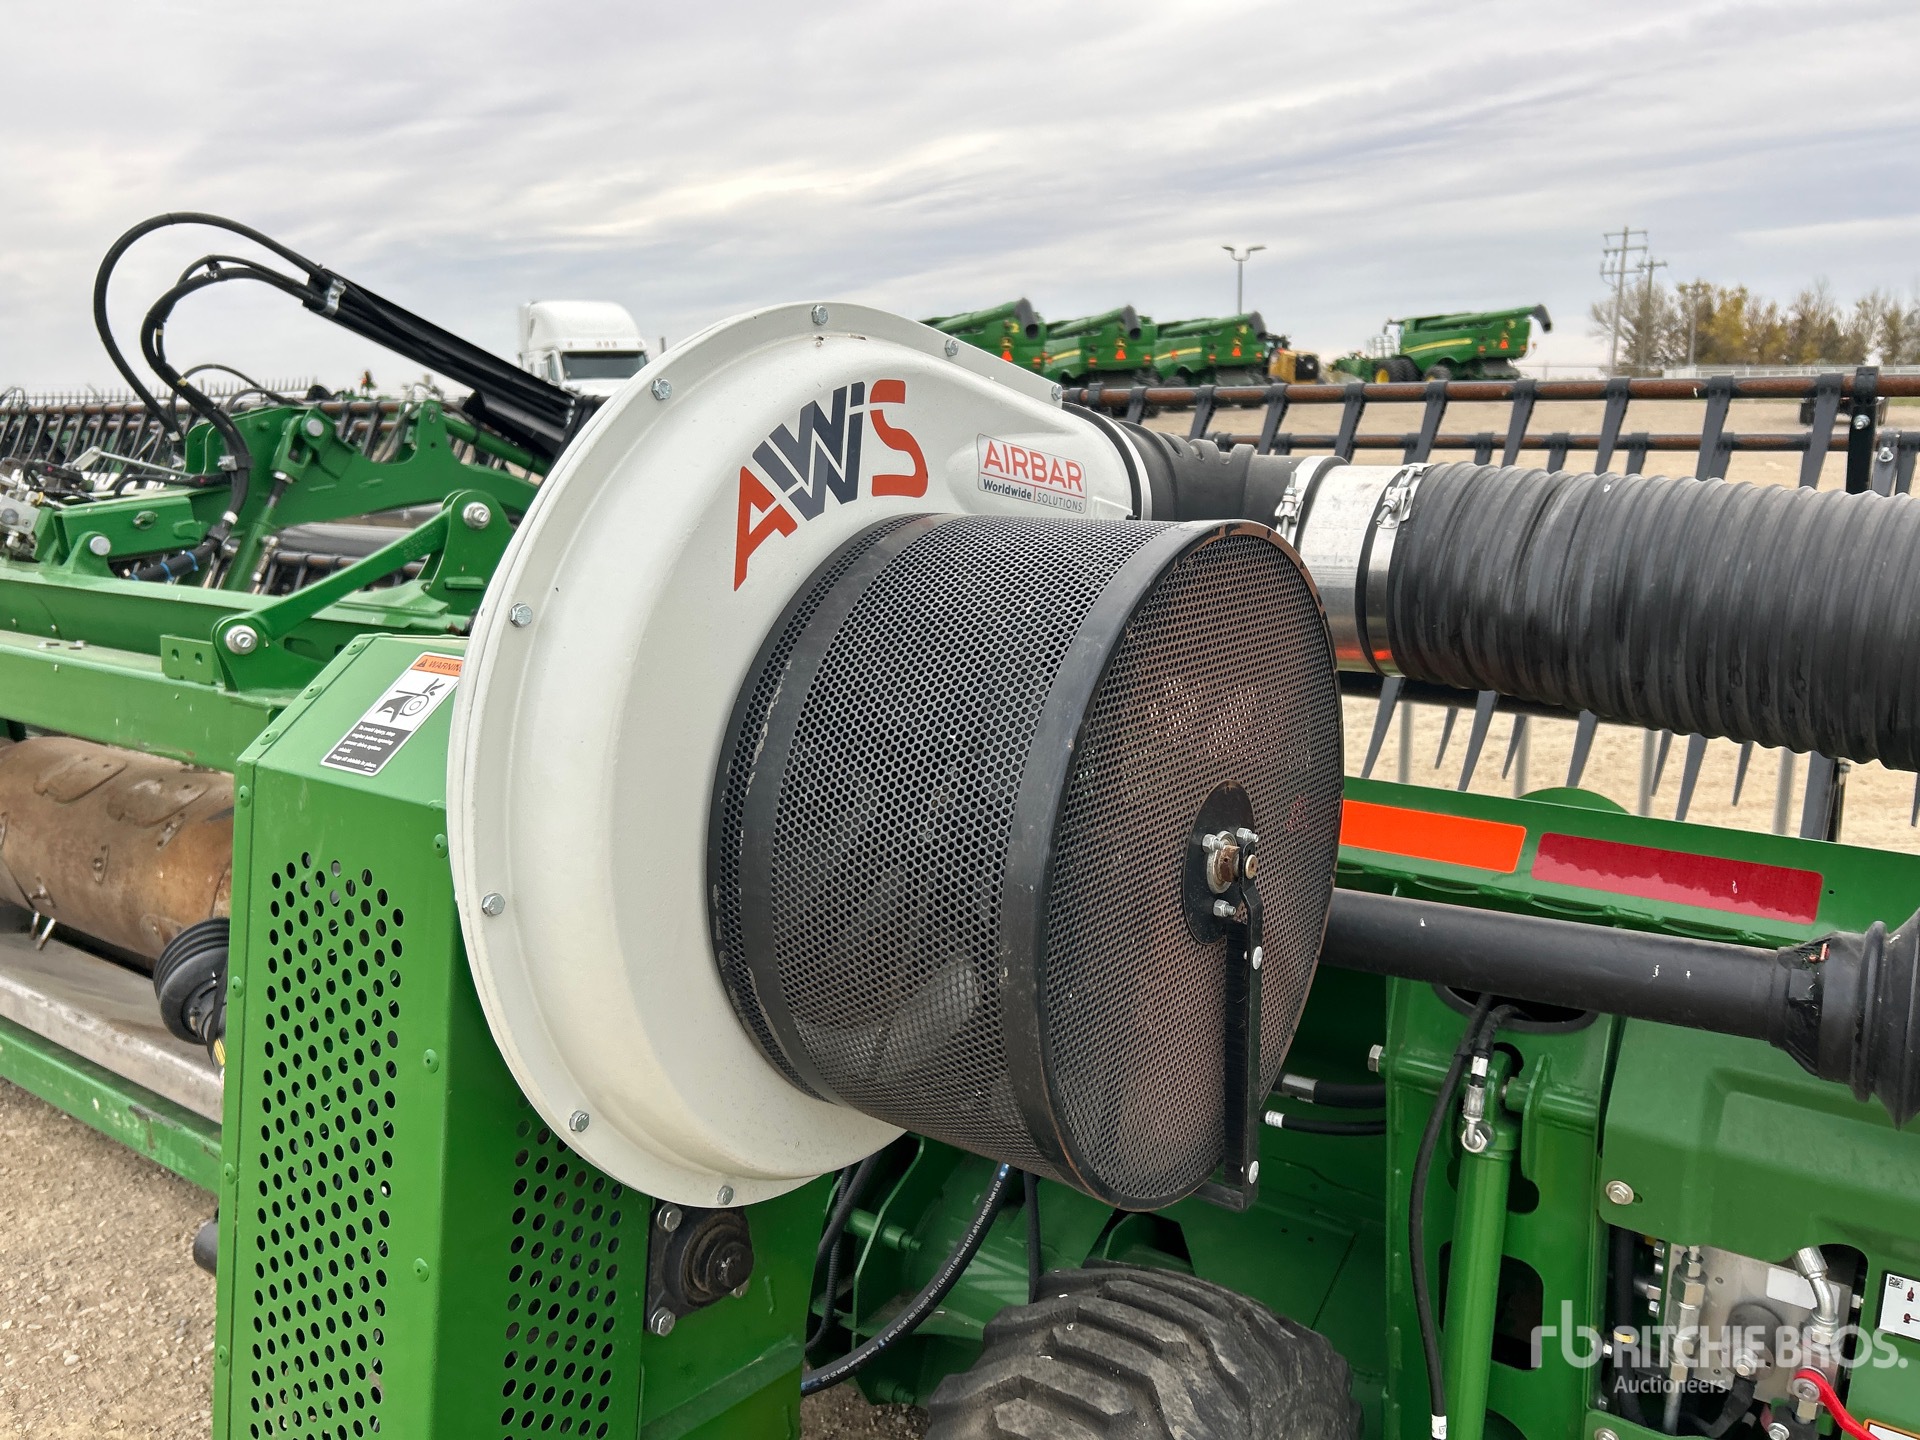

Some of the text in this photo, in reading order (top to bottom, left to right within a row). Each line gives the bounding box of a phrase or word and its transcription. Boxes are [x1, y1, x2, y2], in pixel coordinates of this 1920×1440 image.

[983, 440, 1083, 493] AIRBAR
[983, 478, 1083, 512] Worldwide SOLUTIONS
[429, 660, 463, 672] WARNIN
